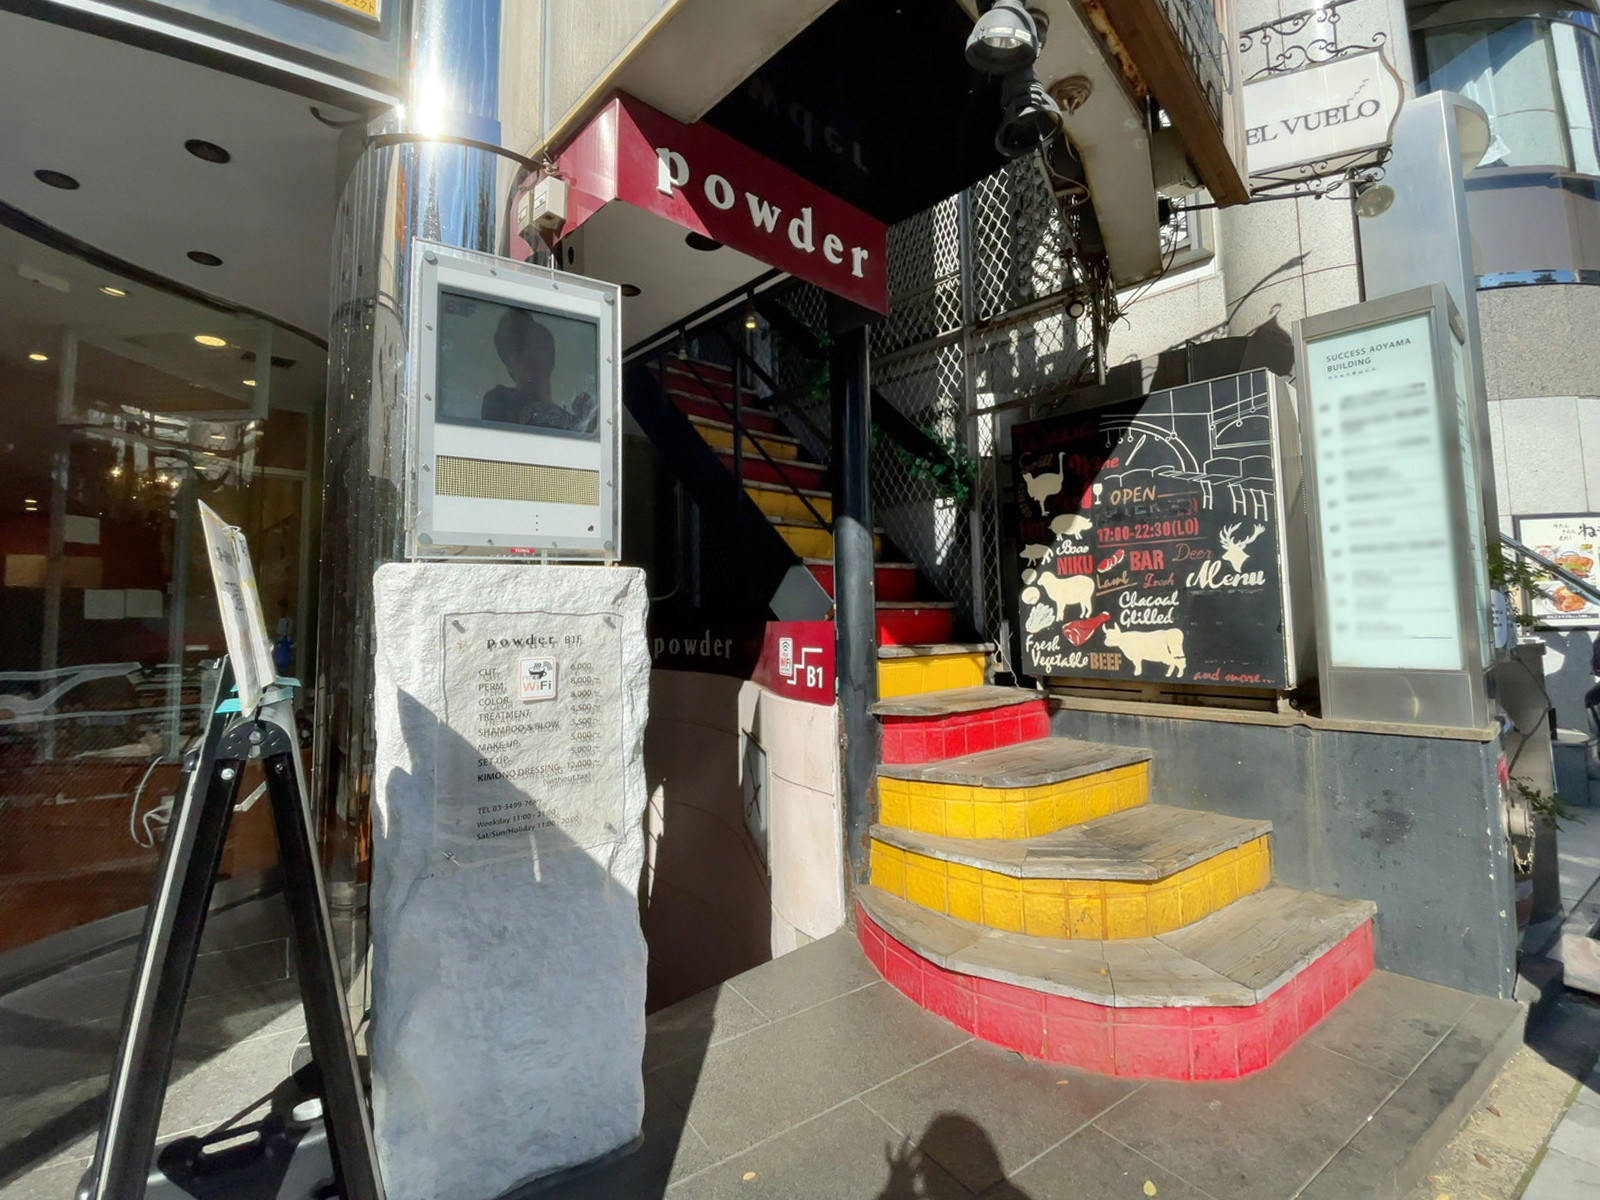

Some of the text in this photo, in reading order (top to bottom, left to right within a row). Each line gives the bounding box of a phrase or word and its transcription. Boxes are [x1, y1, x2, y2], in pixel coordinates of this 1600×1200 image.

[1245, 99, 1380, 146] EL VUELO
[655, 147, 869, 278] powder
[1326, 338, 1411, 363] SUCCESS AOYAMA
[1326, 357, 1372, 372] BUILDING
[1110, 485, 1156, 505] OPEN
[1172, 542, 1214, 562] Deer
[1057, 549, 1164, 575] NIKU BAR
[1186, 560, 1266, 589] Menu
[487, 634, 582, 649] powder B1F
[654, 629, 733, 659] powder
[1025, 634, 1061, 652] Fresh
[1031, 649, 1089, 674] Vegetable
[1089, 652, 1123, 671] BEEF
[478, 668, 497, 677] CUT
[807, 666, 823, 689] B1
[1193, 667, 1221, 680] and
[478, 682, 503, 692] PERM
[523, 680, 552, 691] WiFi
[478, 697, 509, 706] COLOR
[478, 709, 531, 721] TREATMENT
[478, 725, 525, 737] SHAMPOO
[535, 721, 560, 731] BLOW
[478, 741, 506, 751] MAKE
[477, 757, 493, 768] SET
[477, 770, 516, 782] KIMONO
[518, 763, 561, 777] DRESSING
[478, 807, 491, 815] TEL
[476, 816, 512, 829] Weekday
[513, 813, 532, 822] 11:00
[537, 819, 556, 829] 11:00
